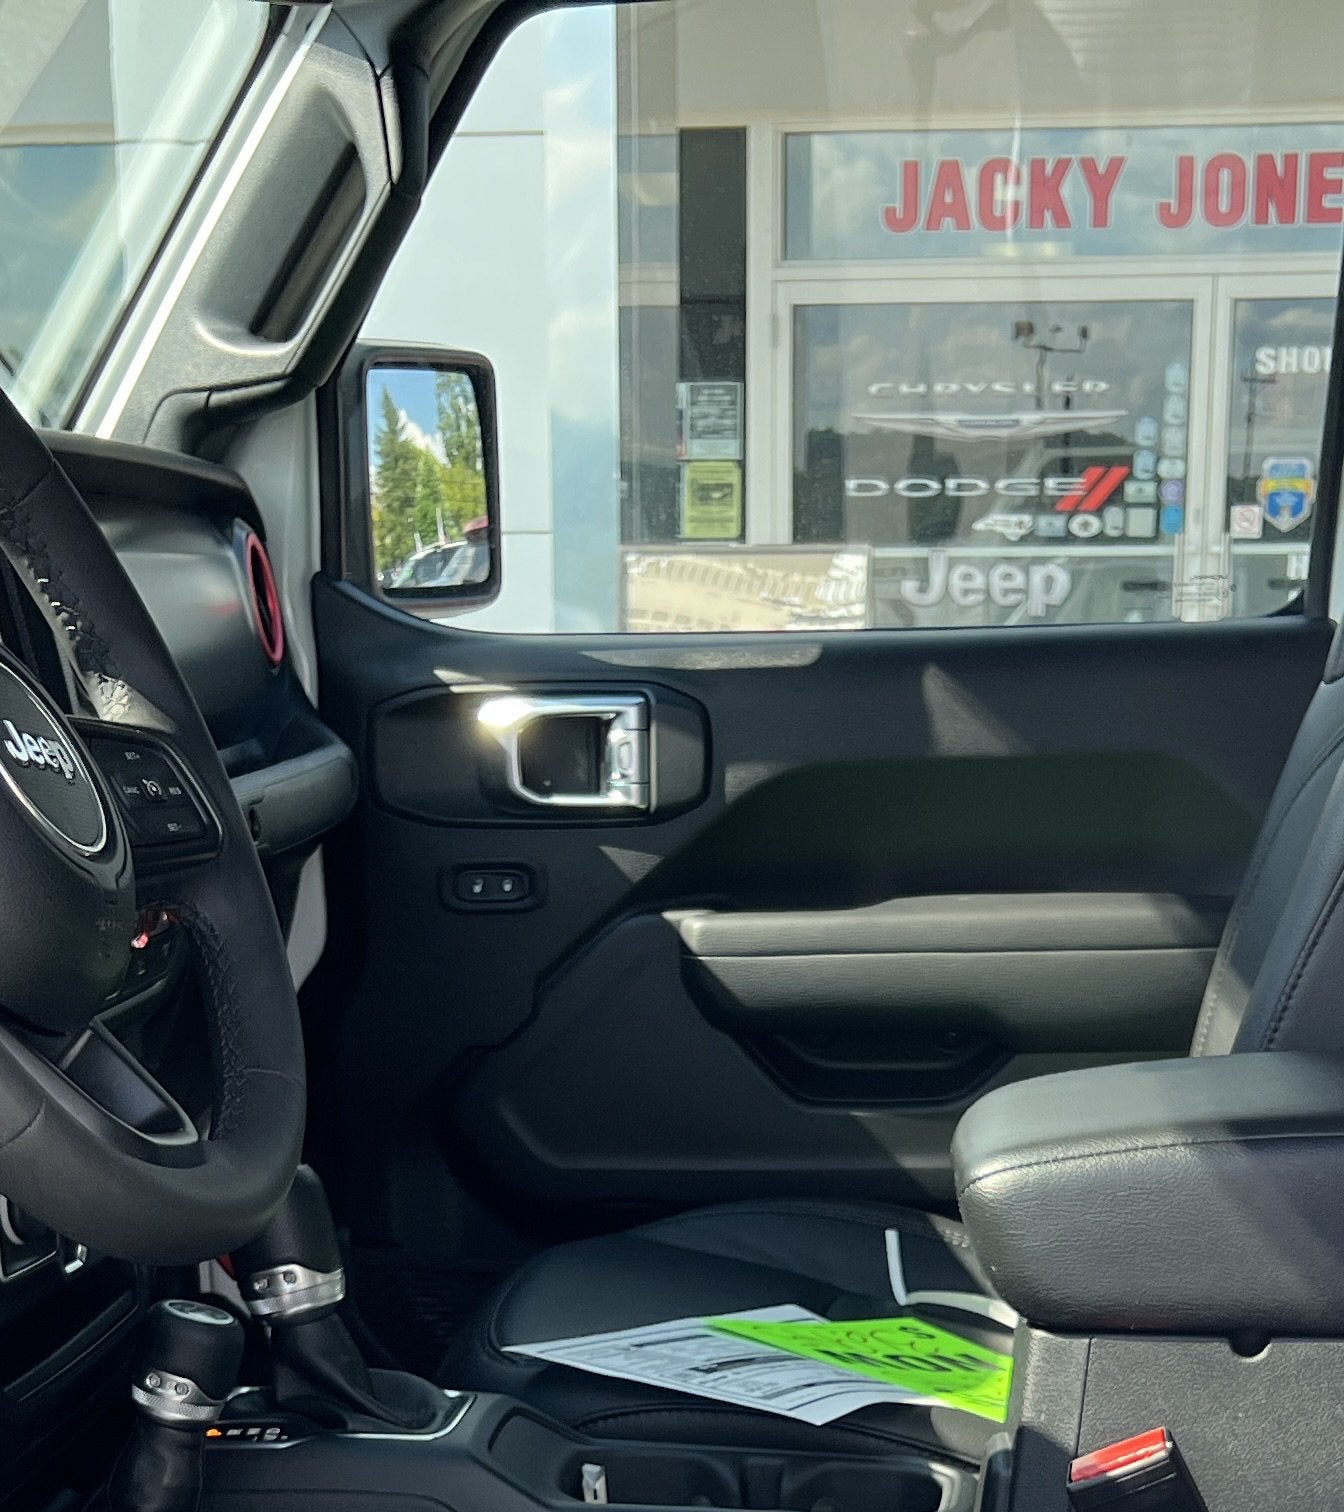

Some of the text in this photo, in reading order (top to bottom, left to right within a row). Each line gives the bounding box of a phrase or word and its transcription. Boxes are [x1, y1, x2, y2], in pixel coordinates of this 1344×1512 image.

[883, 156, 1127, 233] JACKY
[1256, 346, 1331, 374] SHO
[845, 478, 1087, 497] DODGE
[901, 551, 1071, 617] Jeep
[2, 720, 74, 779] Jeep
